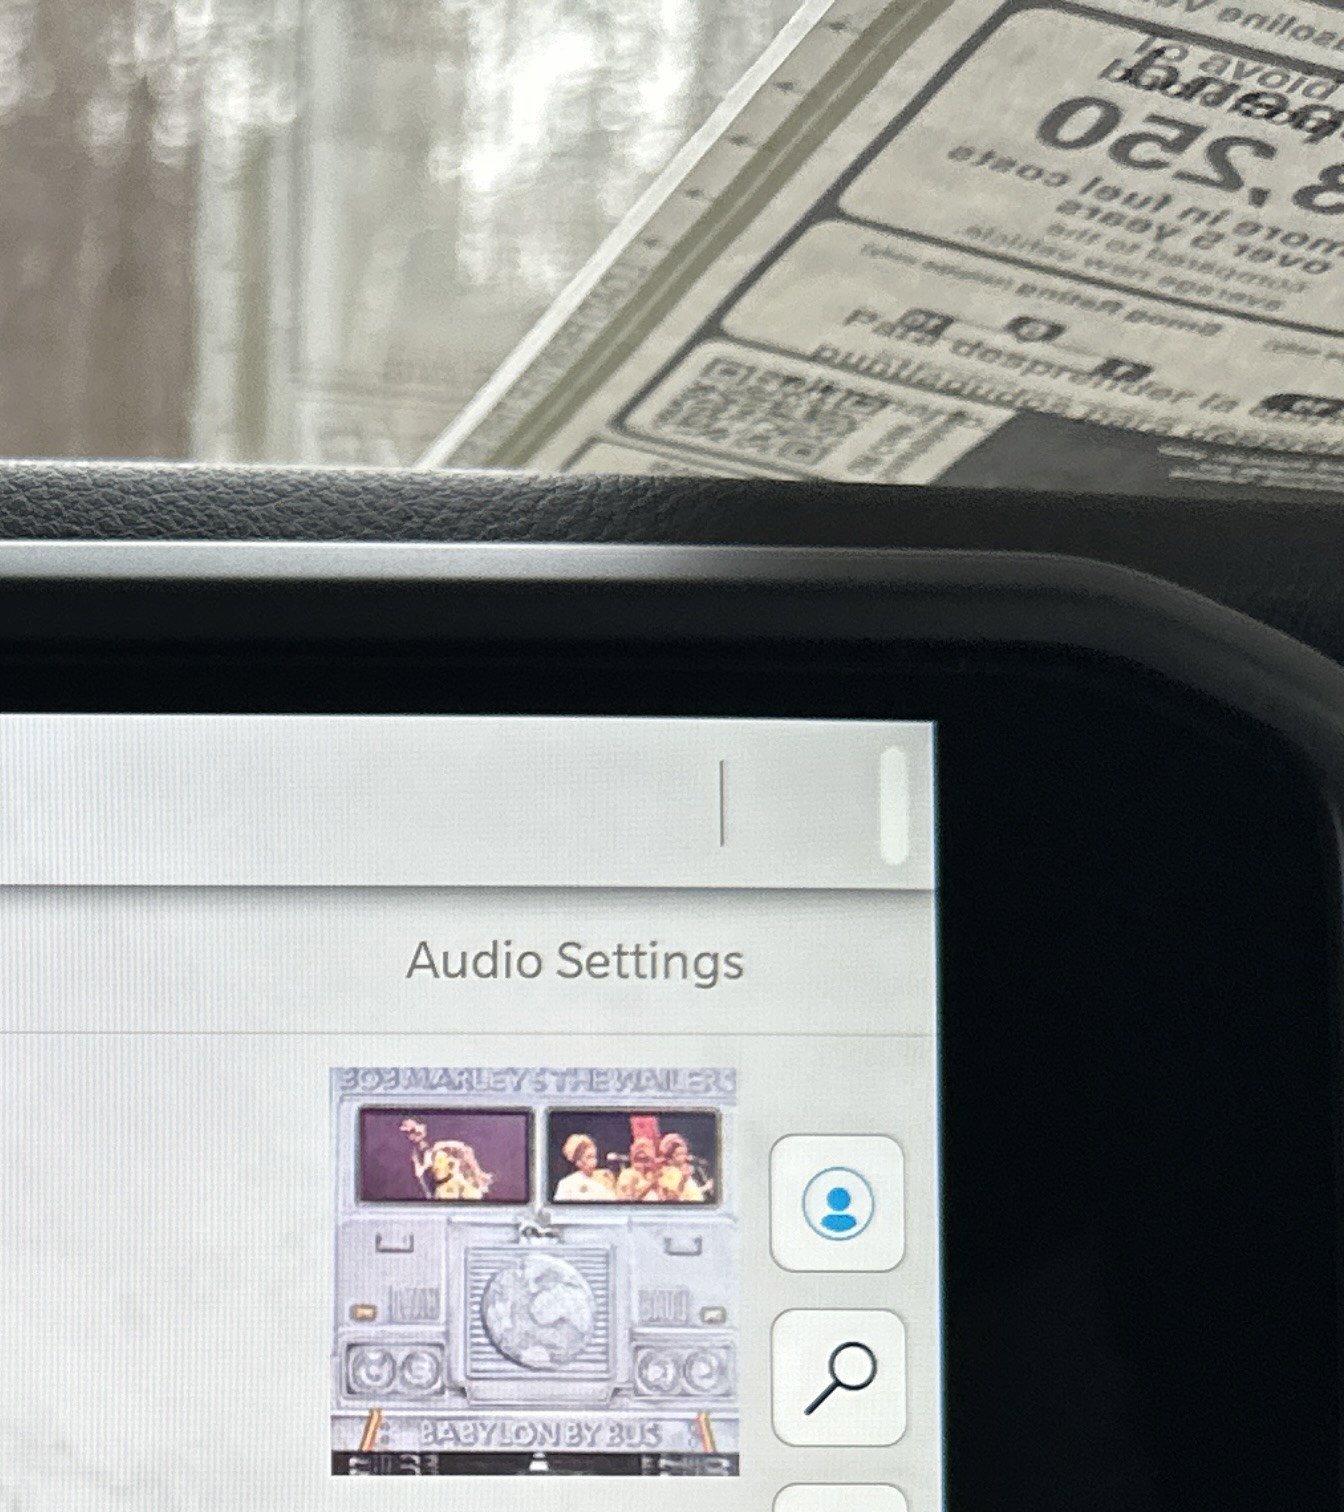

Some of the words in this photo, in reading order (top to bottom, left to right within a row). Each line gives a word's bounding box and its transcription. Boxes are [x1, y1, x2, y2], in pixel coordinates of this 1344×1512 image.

[1198, 54, 1339, 100] avoid
[406, 940, 542, 978] Audio
[557, 941, 743, 989] Settings
